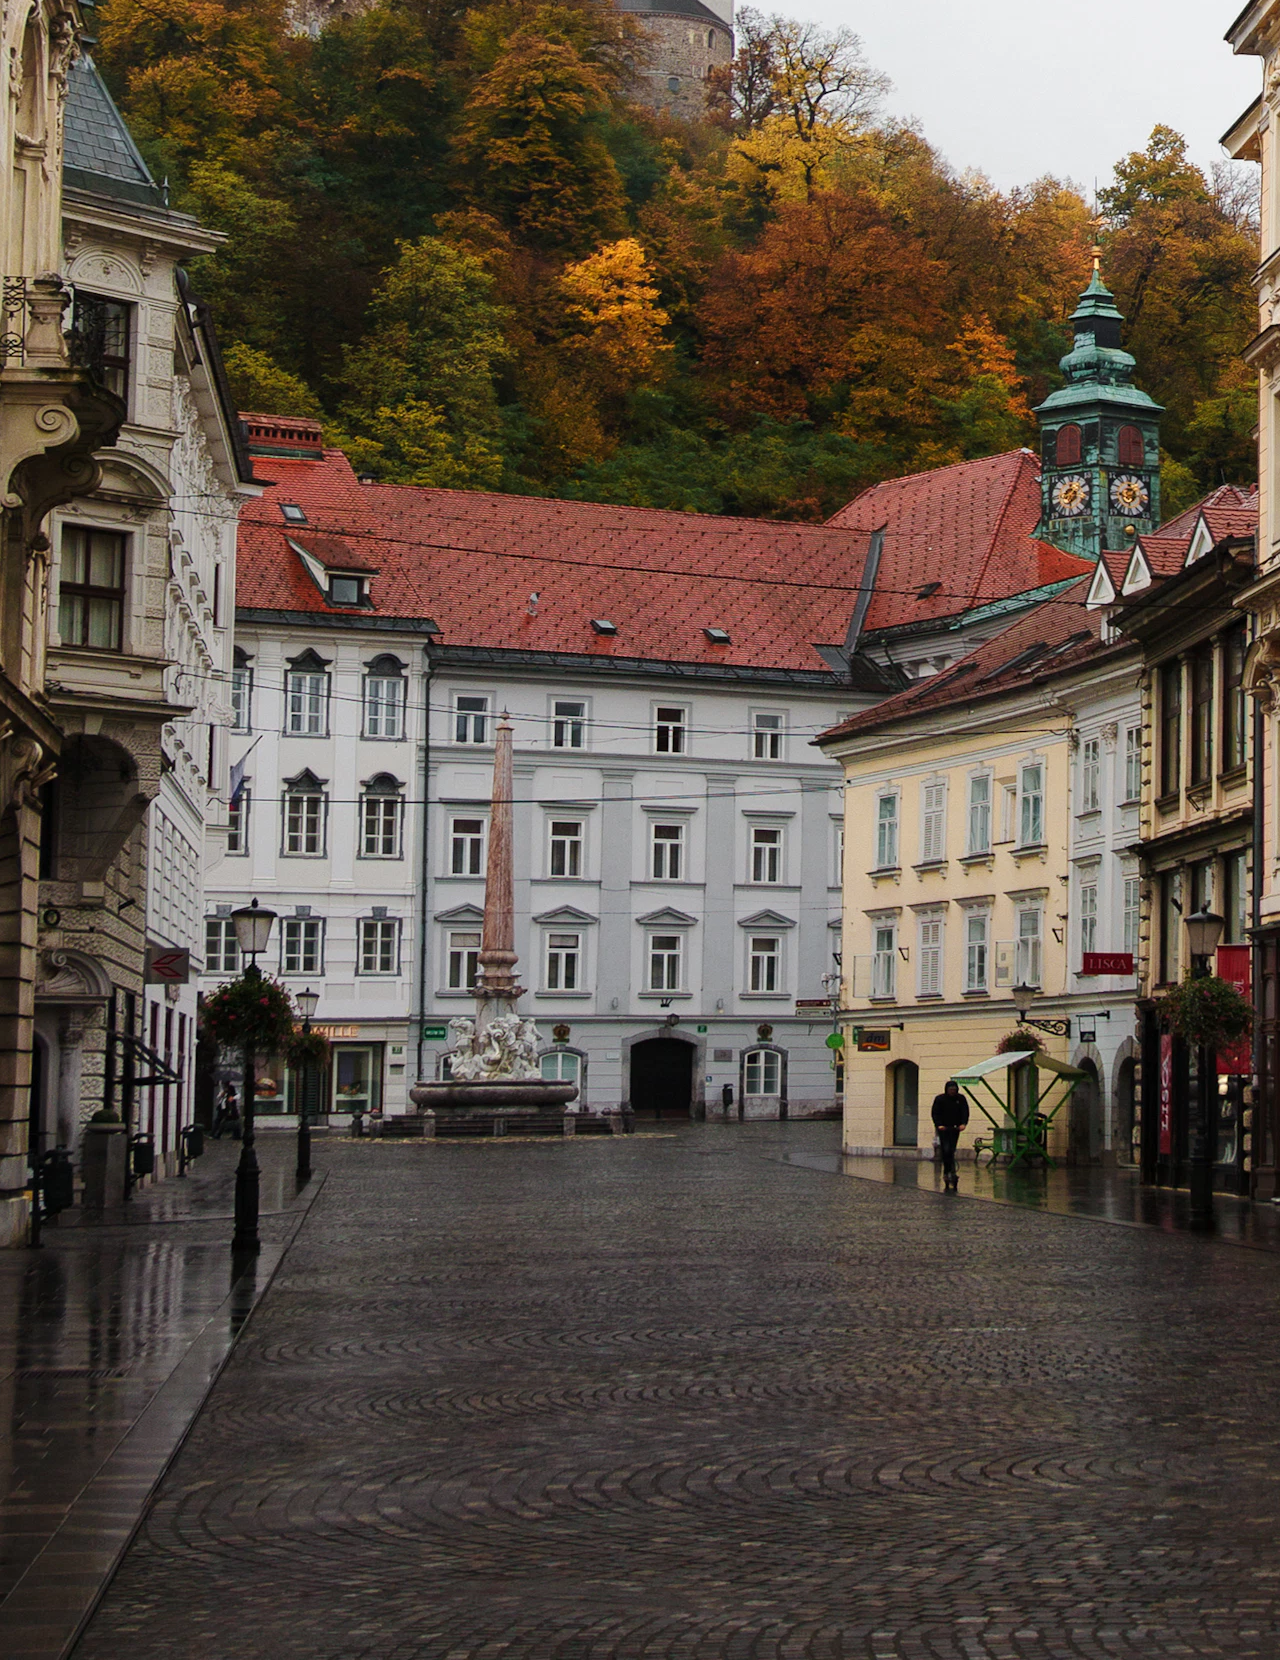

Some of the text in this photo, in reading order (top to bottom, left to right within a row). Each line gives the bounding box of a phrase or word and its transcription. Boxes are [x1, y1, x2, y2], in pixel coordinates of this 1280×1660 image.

[1089, 958, 1127, 970] LISCA
[866, 1032, 885, 1043] dm
[1161, 1053, 1171, 1131] LISCA
